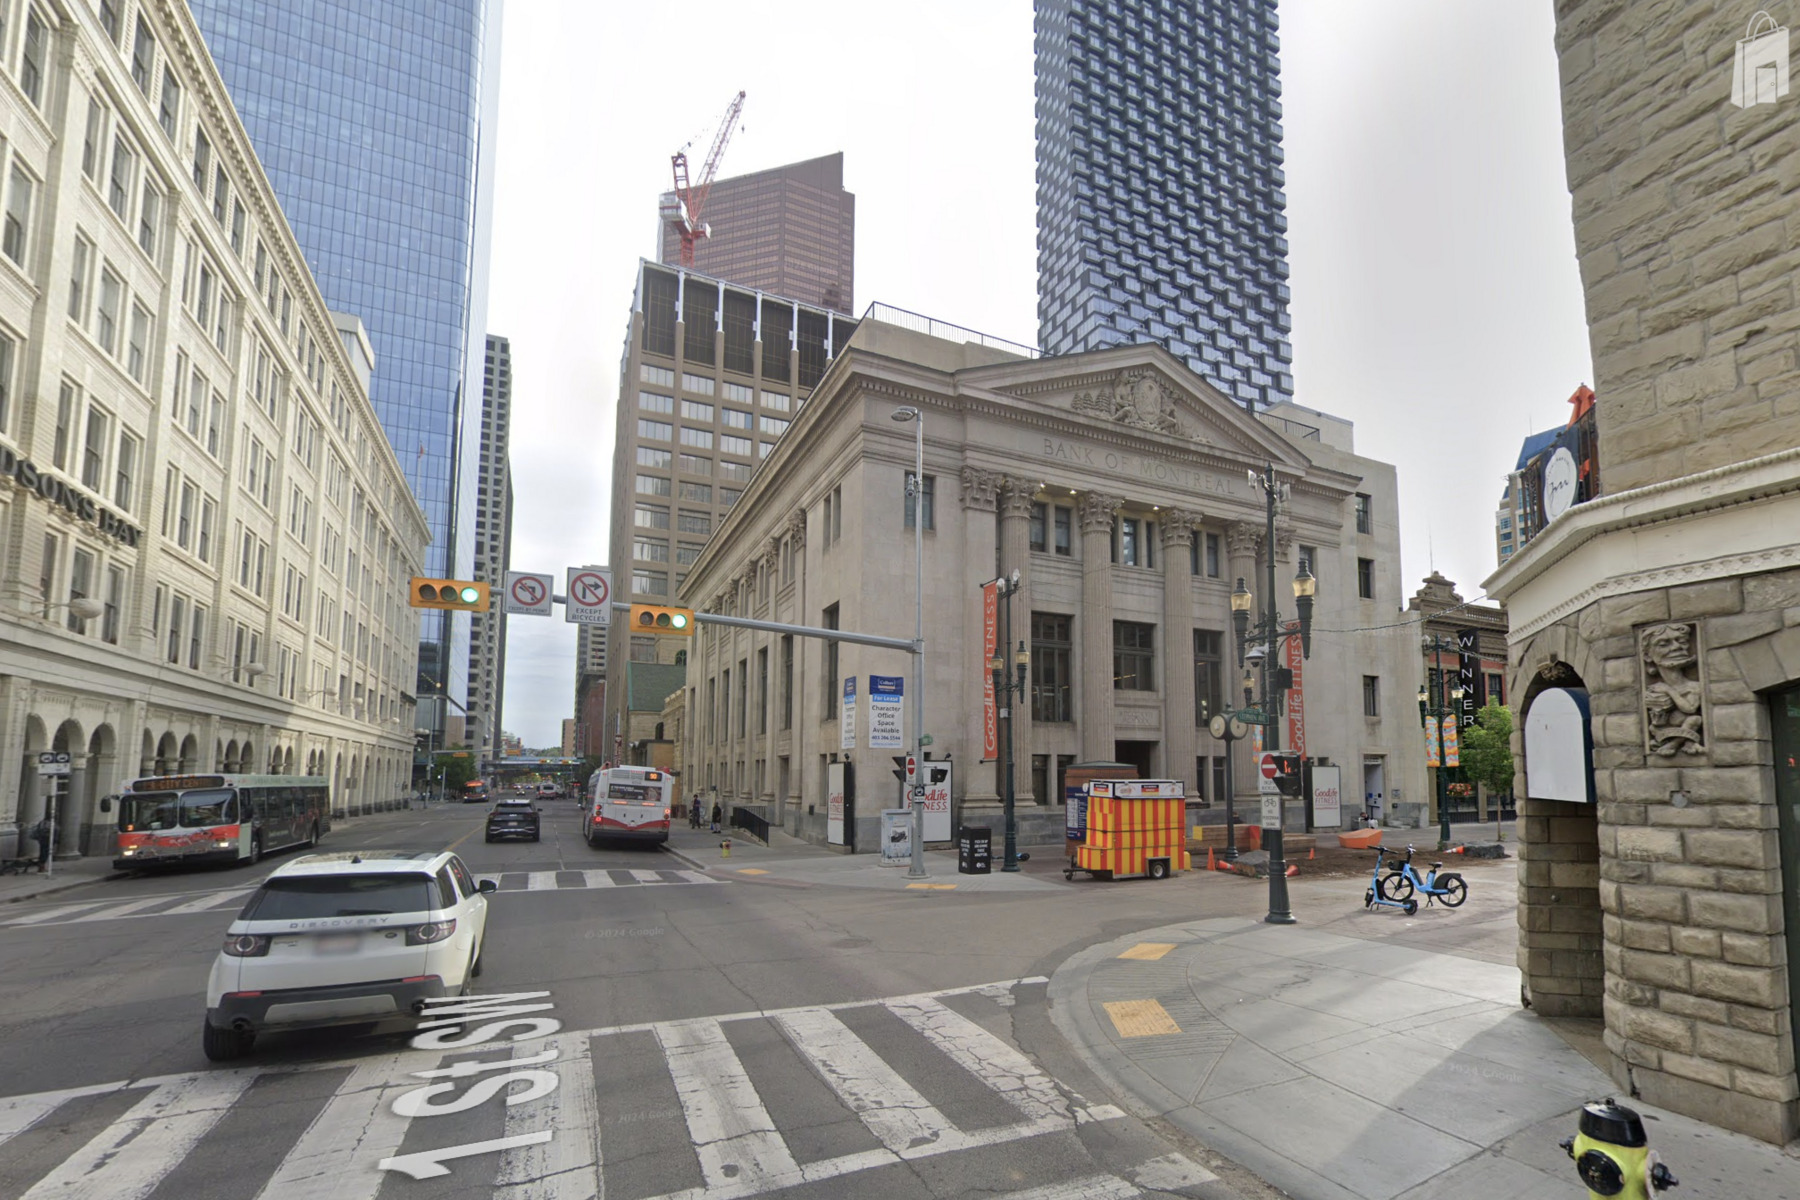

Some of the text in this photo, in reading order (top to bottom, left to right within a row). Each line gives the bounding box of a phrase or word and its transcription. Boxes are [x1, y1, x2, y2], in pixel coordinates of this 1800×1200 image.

[1043, 438, 1235, 494] BANK OF MONTREAL
[98, 507, 141, 546] BAY
[575, 607, 602, 615] EXCEPT
[571, 614, 606, 622] BICYCLES
[984, 593, 995, 752] GoodLife FITNESS
[1457, 635, 1474, 726] WINNER
[1290, 694, 1304, 756] GoodLife
[160, 779, 180, 789] CITY
[906, 789, 947, 802] GdLife
[1314, 788, 1338, 797] GoodLife
[907, 801, 947, 810] FNESS
[289, 917, 389, 929] DISCOVERY
